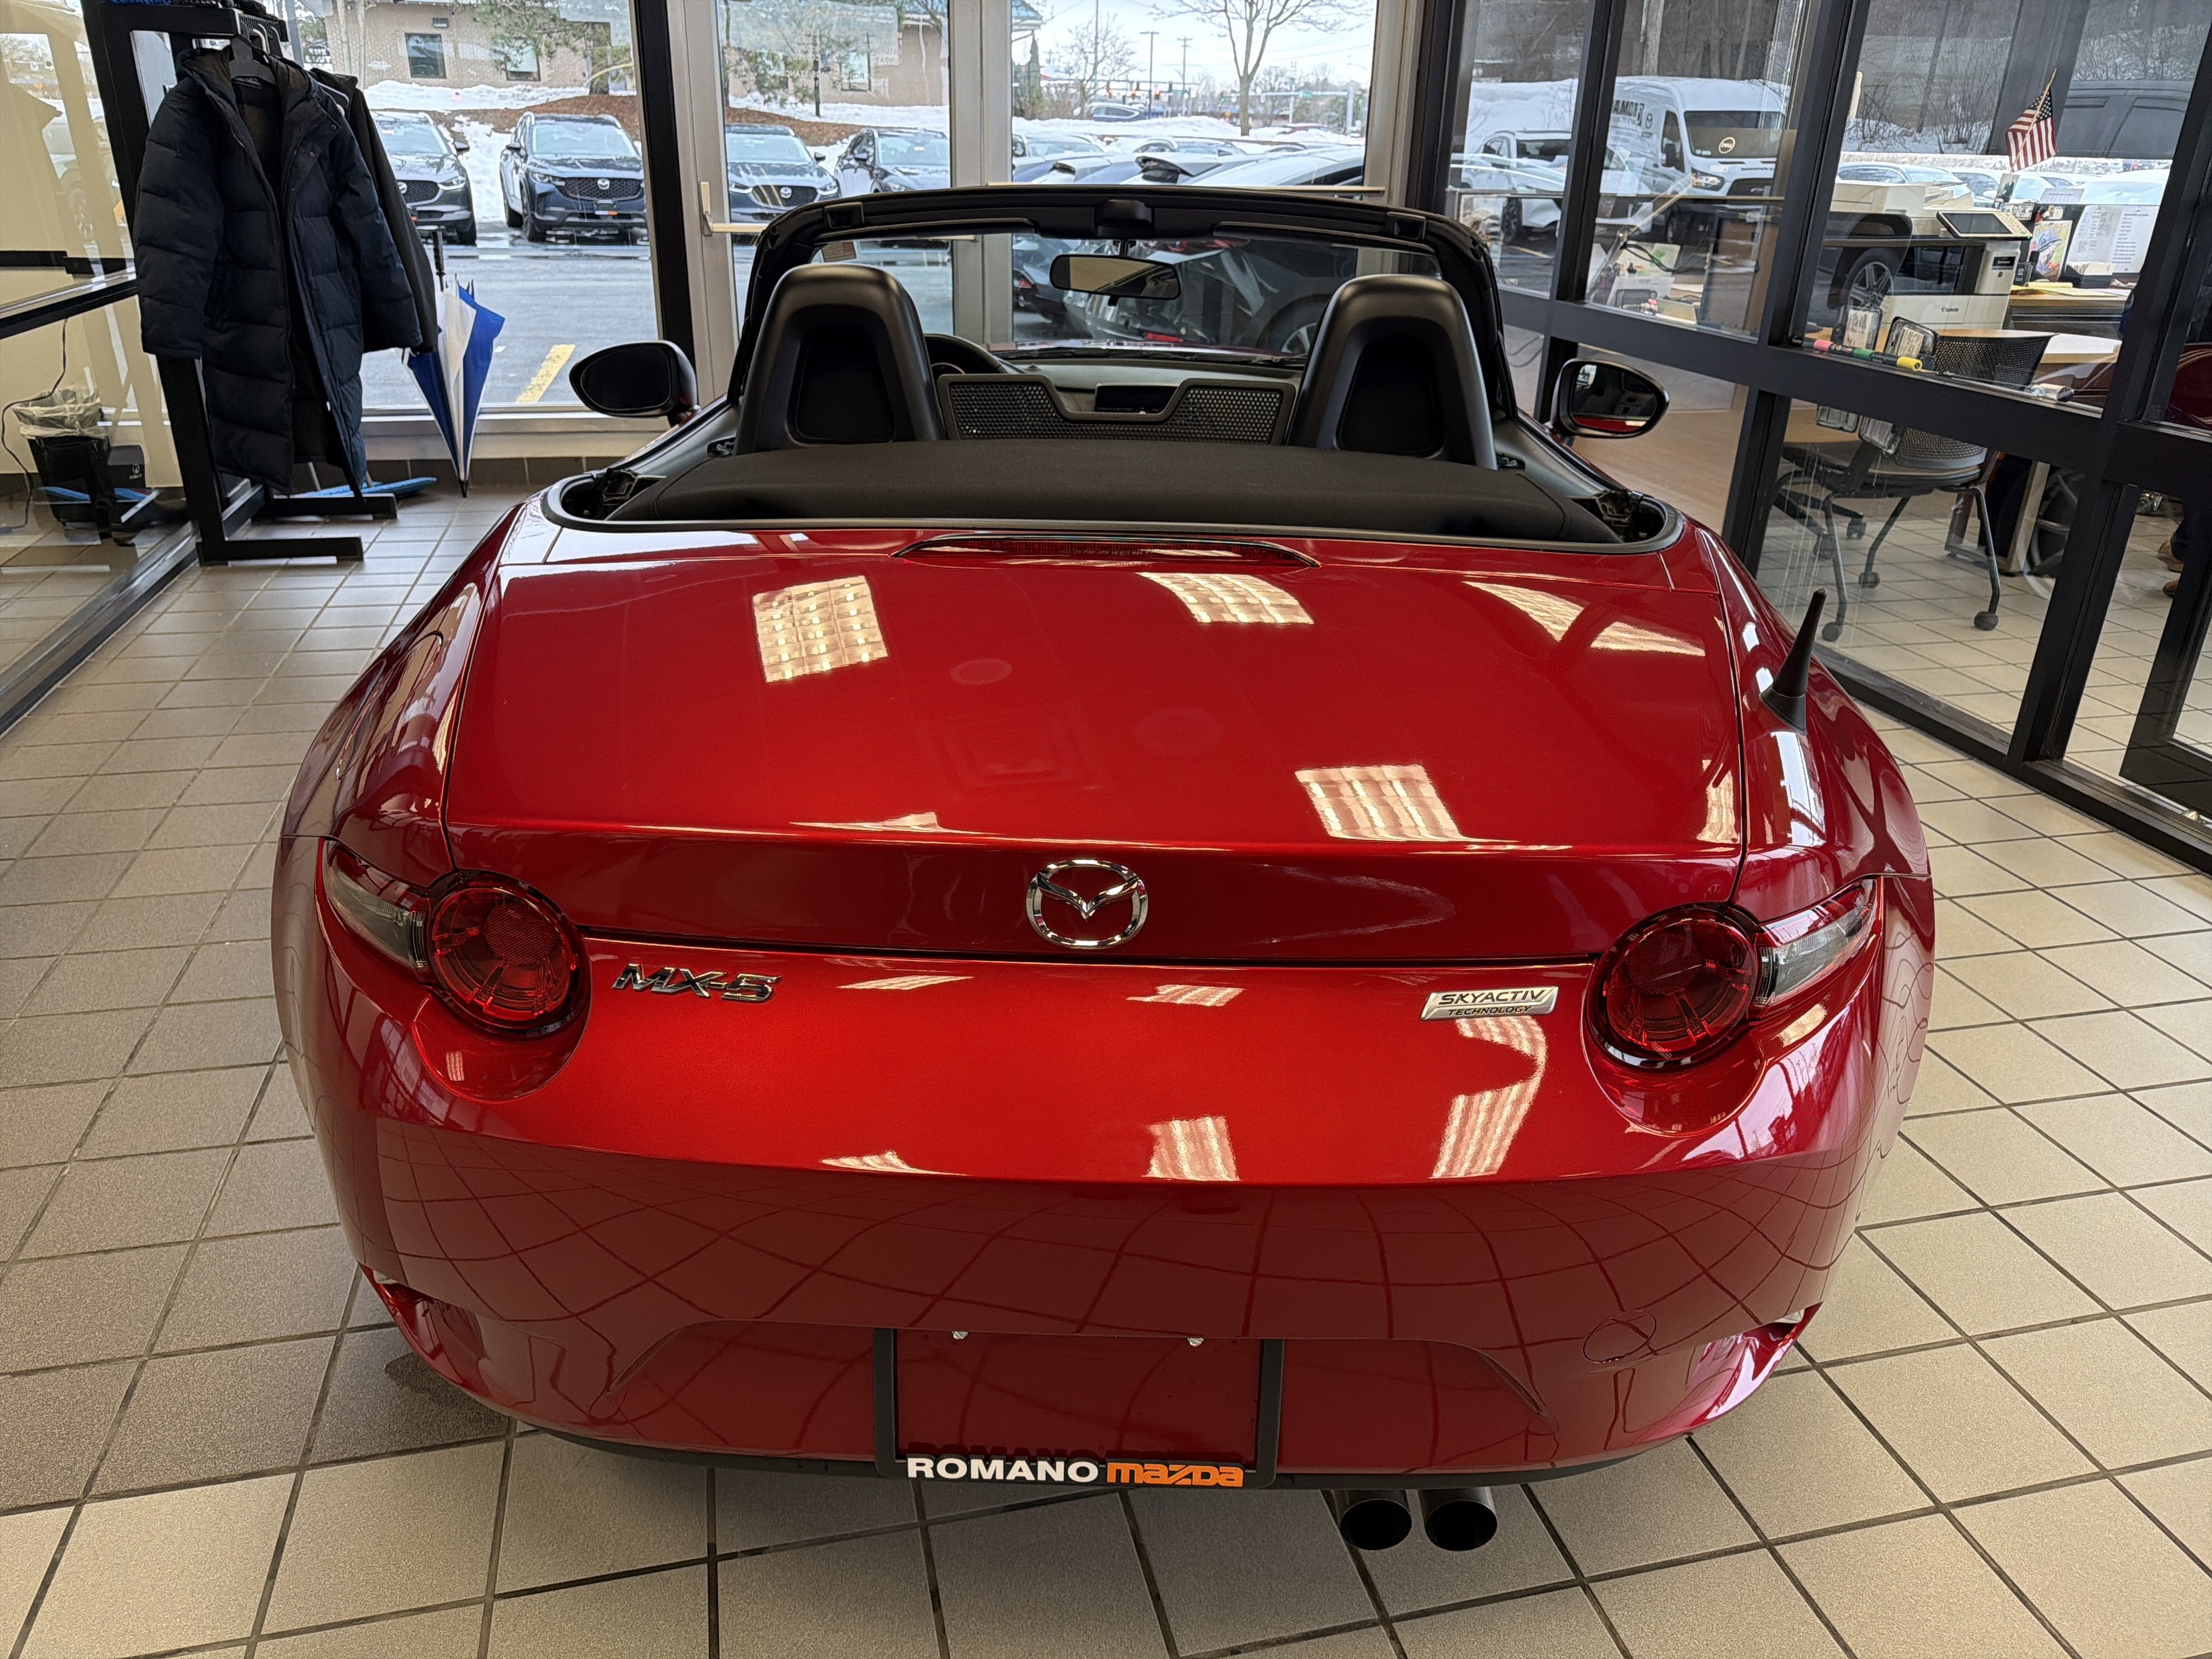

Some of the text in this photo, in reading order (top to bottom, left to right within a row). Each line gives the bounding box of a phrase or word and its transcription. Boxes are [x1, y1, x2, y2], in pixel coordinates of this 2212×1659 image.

[612, 962, 782, 1002] MX-5
[1438, 990, 1545, 1005] SKYACTIV
[1448, 1006, 1533, 1016] TECHNOLOGY
[907, 1458, 1243, 1487] ROMANO mazda
